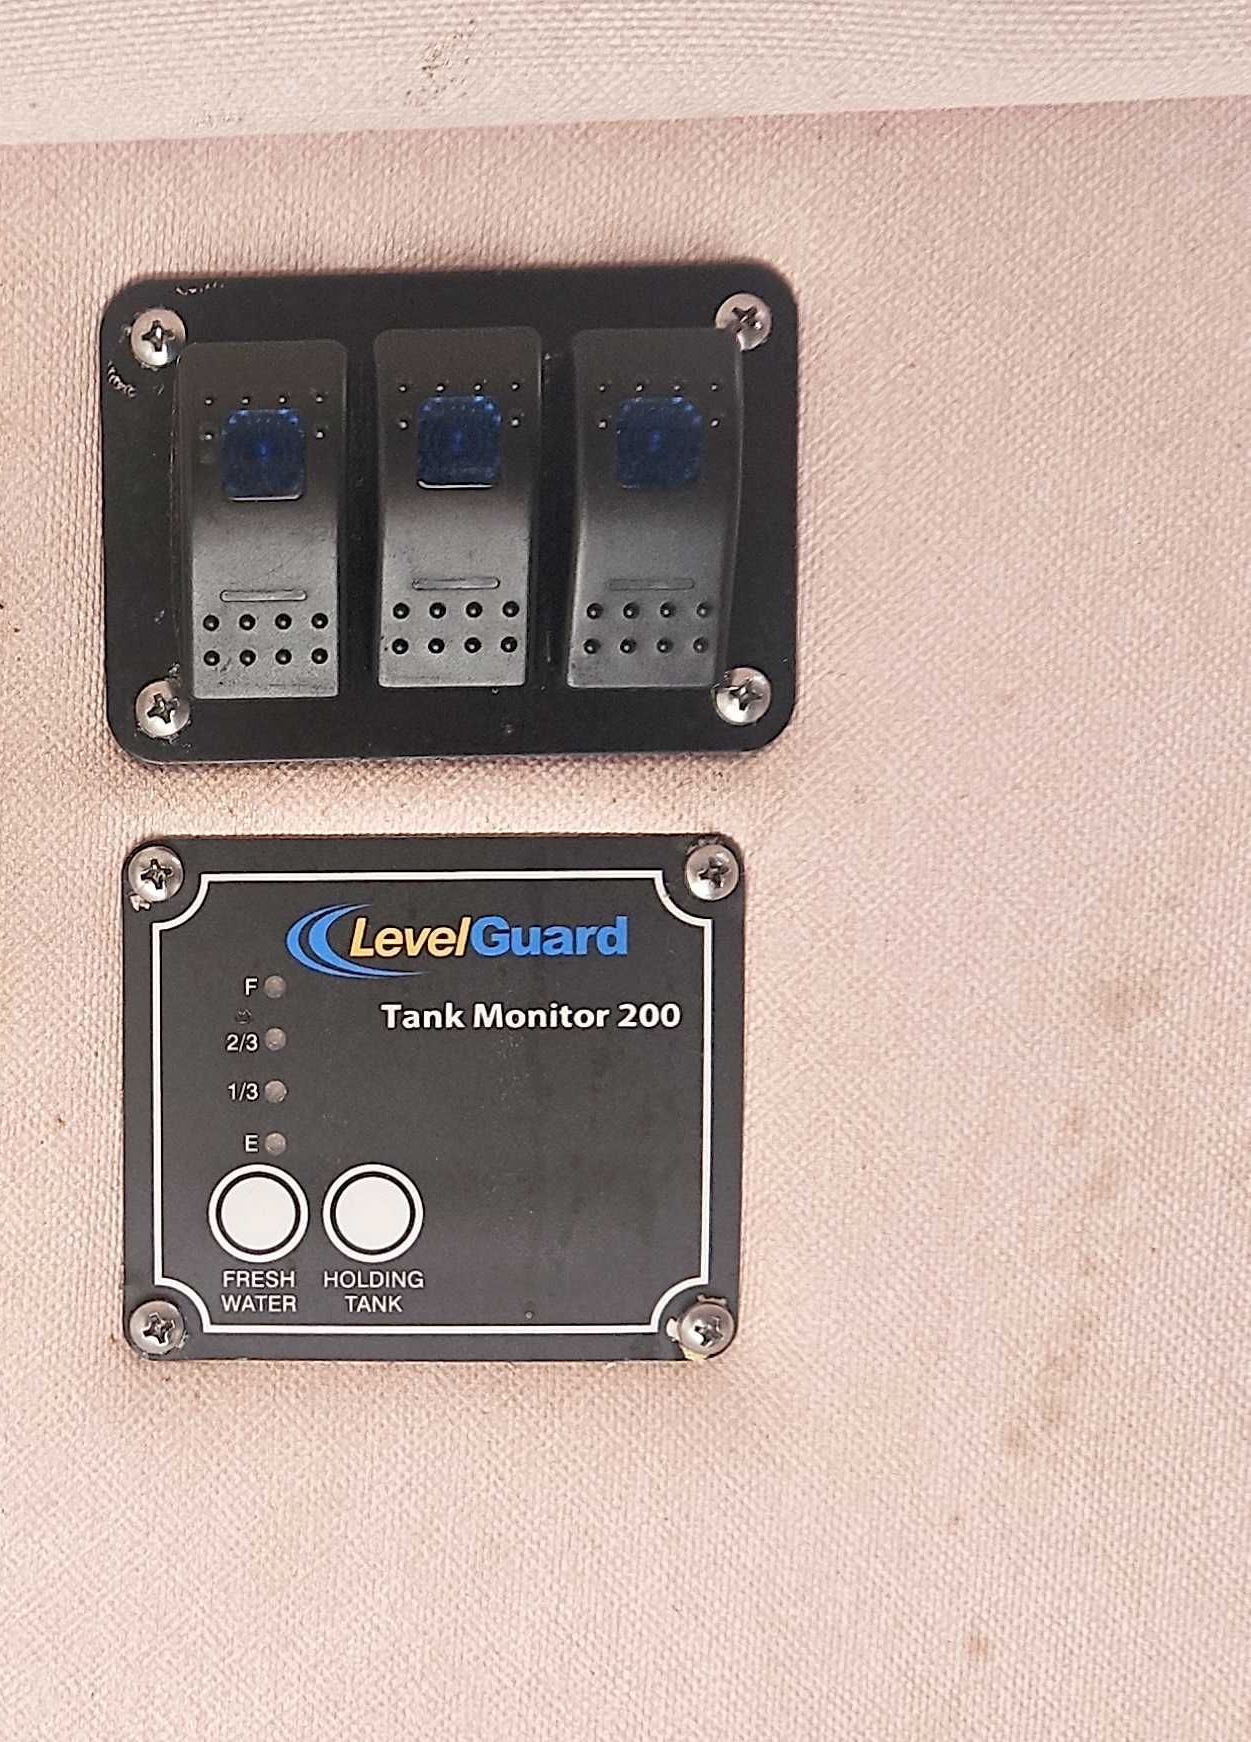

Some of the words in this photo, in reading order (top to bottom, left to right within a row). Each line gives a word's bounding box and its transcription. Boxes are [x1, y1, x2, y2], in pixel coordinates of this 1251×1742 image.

[348, 914, 629, 958] LevelGuard
[244, 978, 259, 996] F
[381, 1002, 465, 1029] Tank
[472, 1002, 611, 1029] Monitor
[616, 1002, 682, 1029] 200
[225, 1033, 260, 1053] 2/3
[227, 1082, 260, 1101] 1/3
[244, 1135, 259, 1153] E
[222, 1270, 296, 1289] FRESH
[323, 1270, 425, 1289] HOLDING
[221, 1294, 297, 1313] WATER
[345, 1294, 403, 1313] TANK
